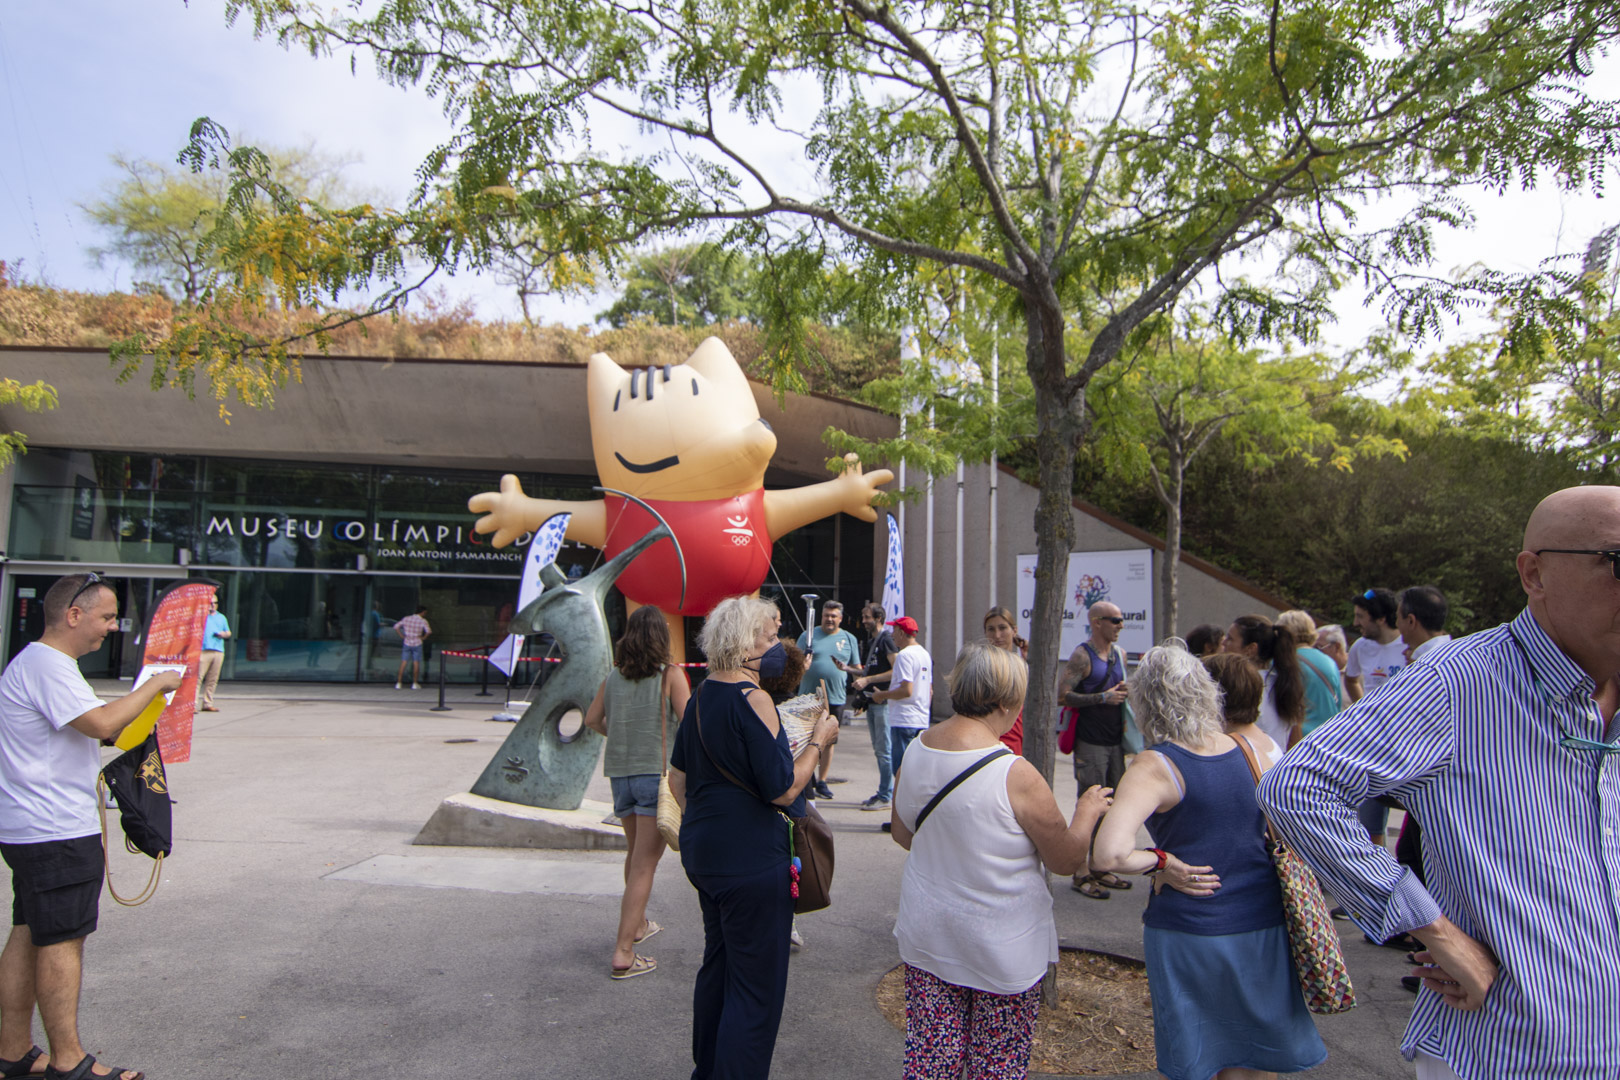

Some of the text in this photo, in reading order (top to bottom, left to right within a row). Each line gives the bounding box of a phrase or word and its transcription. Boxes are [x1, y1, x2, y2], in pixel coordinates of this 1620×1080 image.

[206, 516, 323, 539] MUSEU
[377, 548, 522, 561] JOAN ANTONI SAMARANCH
